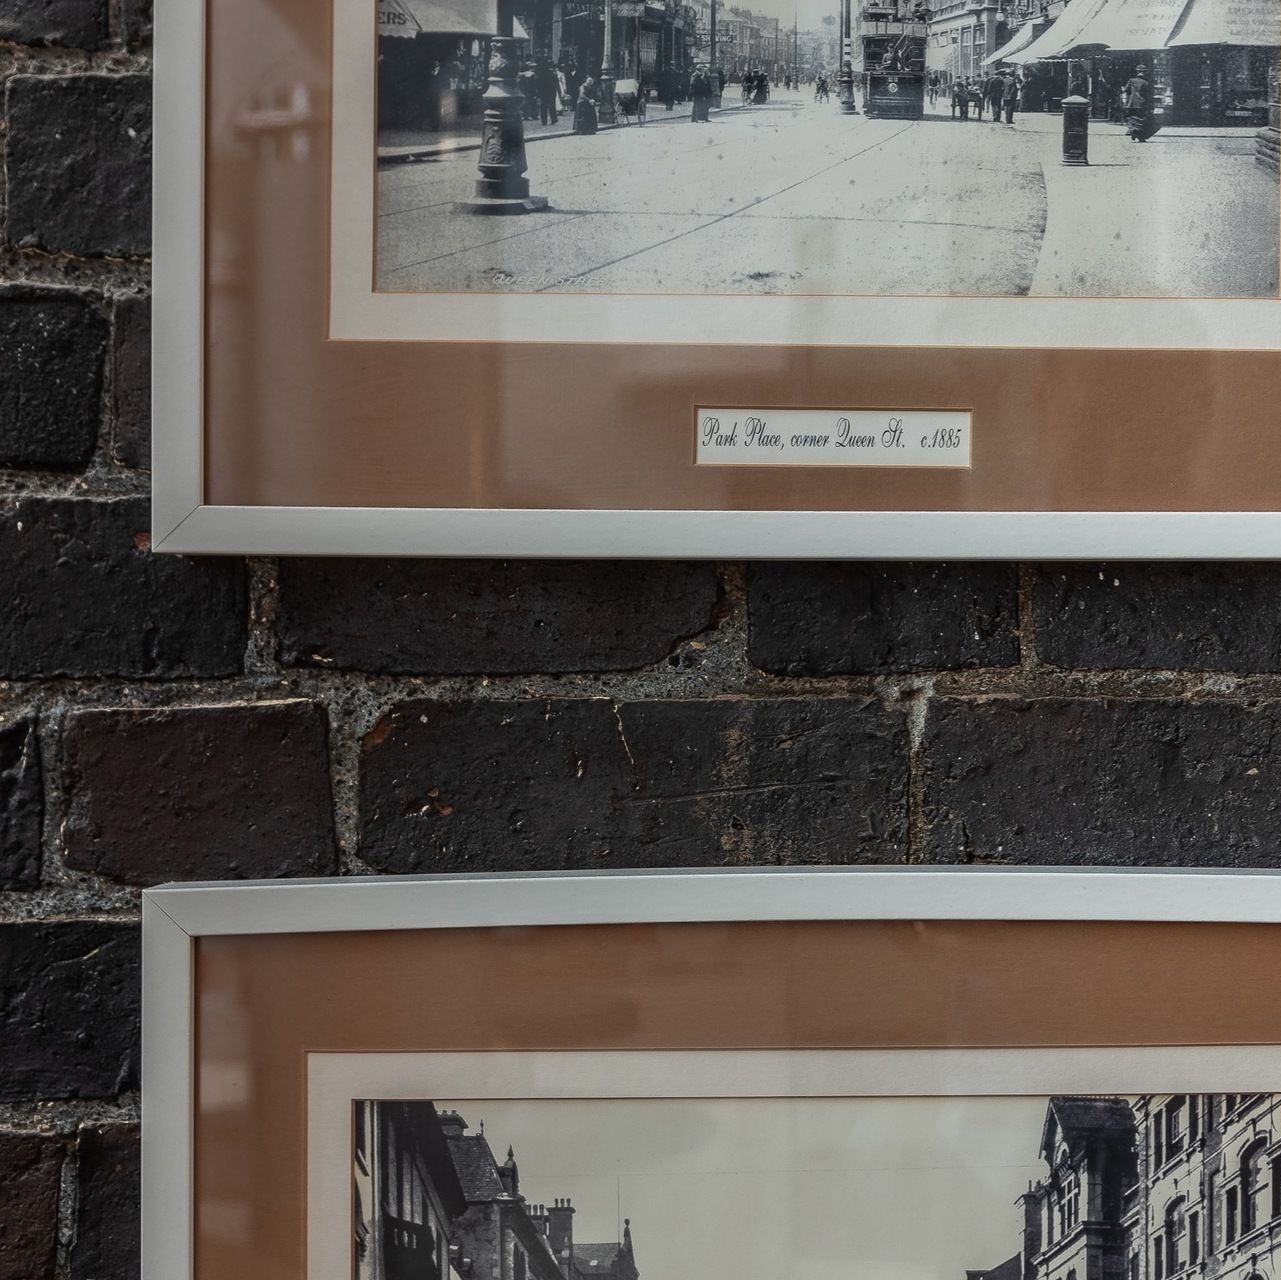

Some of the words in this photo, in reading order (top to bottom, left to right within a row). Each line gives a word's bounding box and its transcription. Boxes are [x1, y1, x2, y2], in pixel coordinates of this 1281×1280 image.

[702, 416, 738, 447] Park
[744, 416, 785, 451] Place,
[790, 432, 829, 448] corner
[835, 416, 876, 449] Queen
[881, 417, 906, 449] St.
[920, 427, 962, 449] c.1885
